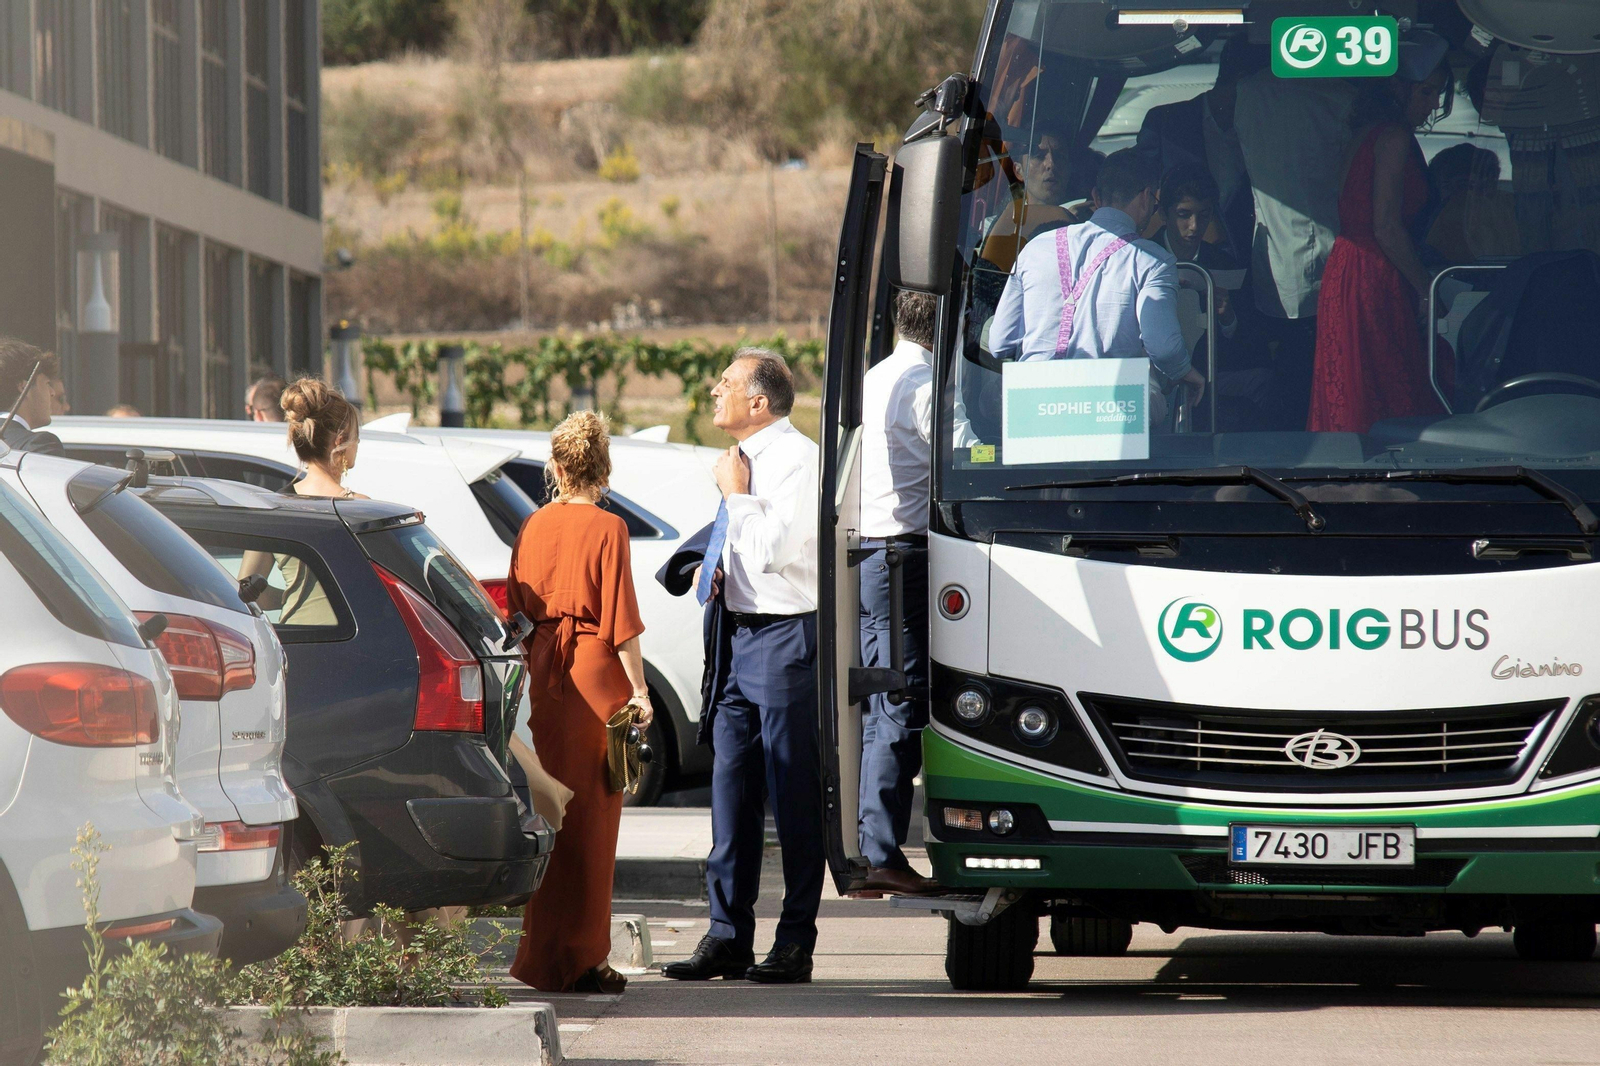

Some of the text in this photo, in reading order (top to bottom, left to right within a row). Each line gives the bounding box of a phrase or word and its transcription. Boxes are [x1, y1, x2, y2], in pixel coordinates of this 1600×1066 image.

[1336, 26, 1391, 65] 39
[1038, 400, 1137, 416] SOPHIE KORS
[1096, 413, 1137, 424] weddings
[1243, 608, 1490, 651] ROIGBUS
[1491, 654, 1583, 680] Gianino
[1236, 847, 1244, 856] E
[1254, 831, 1401, 860] 7430 JFB
